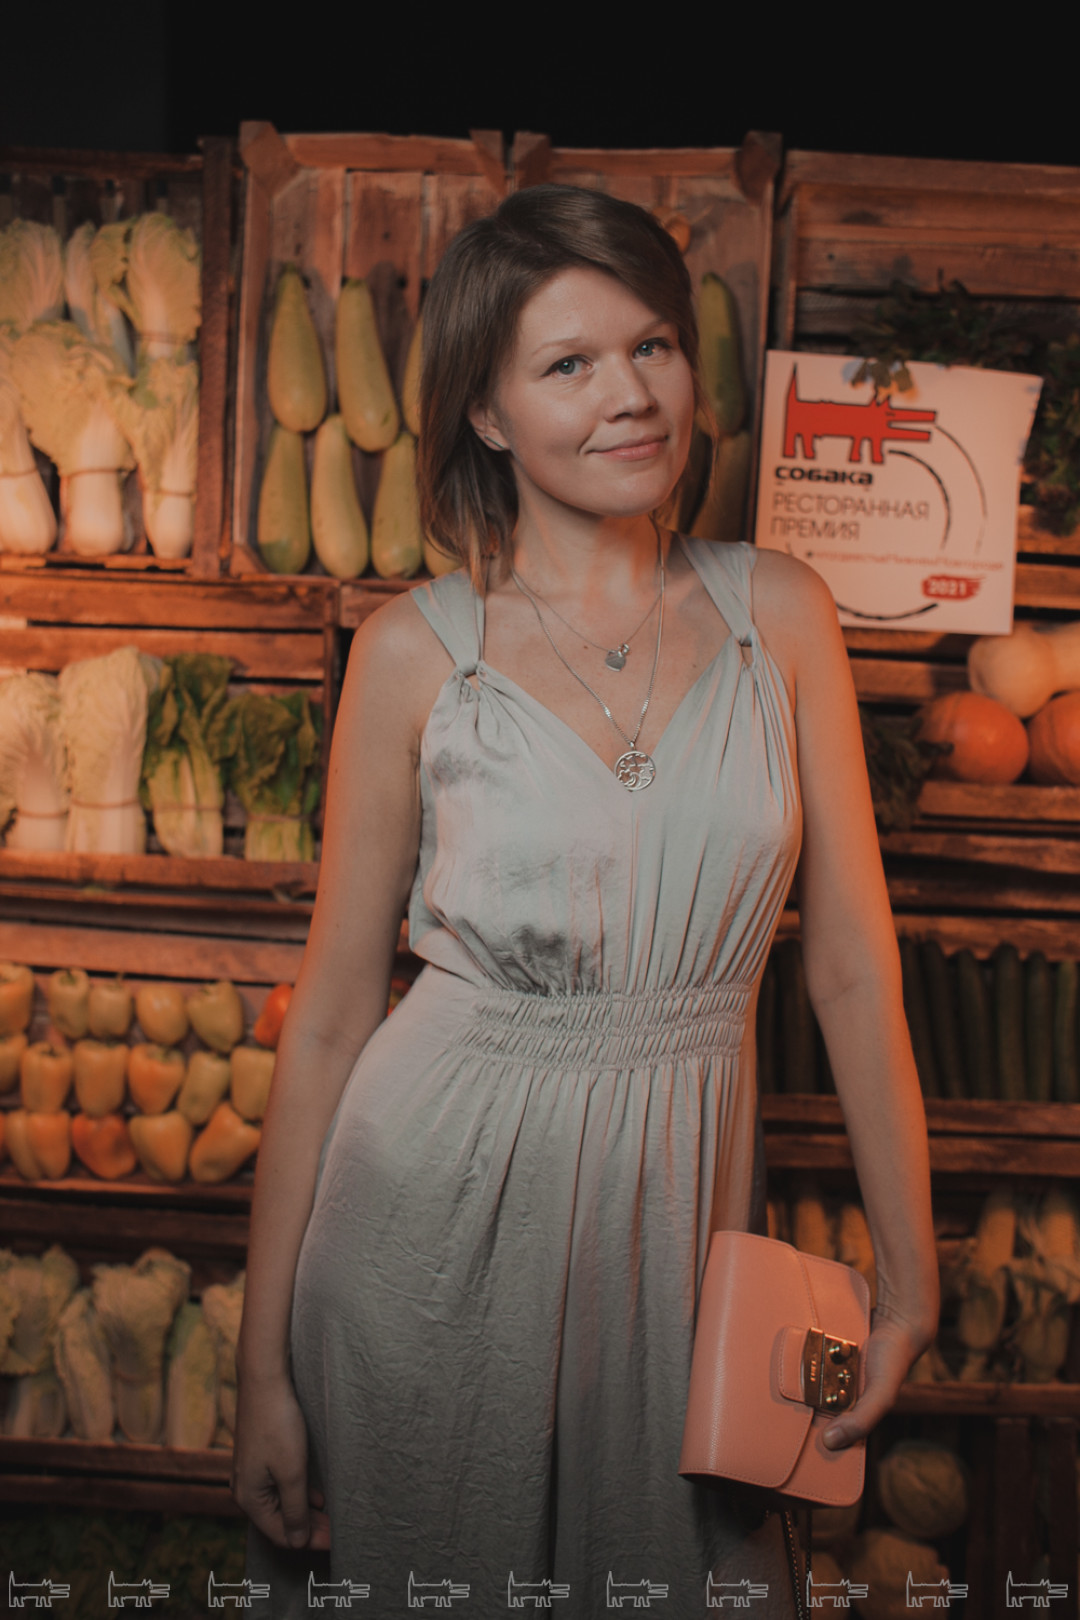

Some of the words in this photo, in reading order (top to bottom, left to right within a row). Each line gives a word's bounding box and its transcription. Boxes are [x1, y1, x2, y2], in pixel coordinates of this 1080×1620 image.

[773, 492, 929, 520] РЕСТОРАННАЯ
[770, 516, 860, 540] ПРЕМИЯ
[927, 579, 967, 597] 2021
